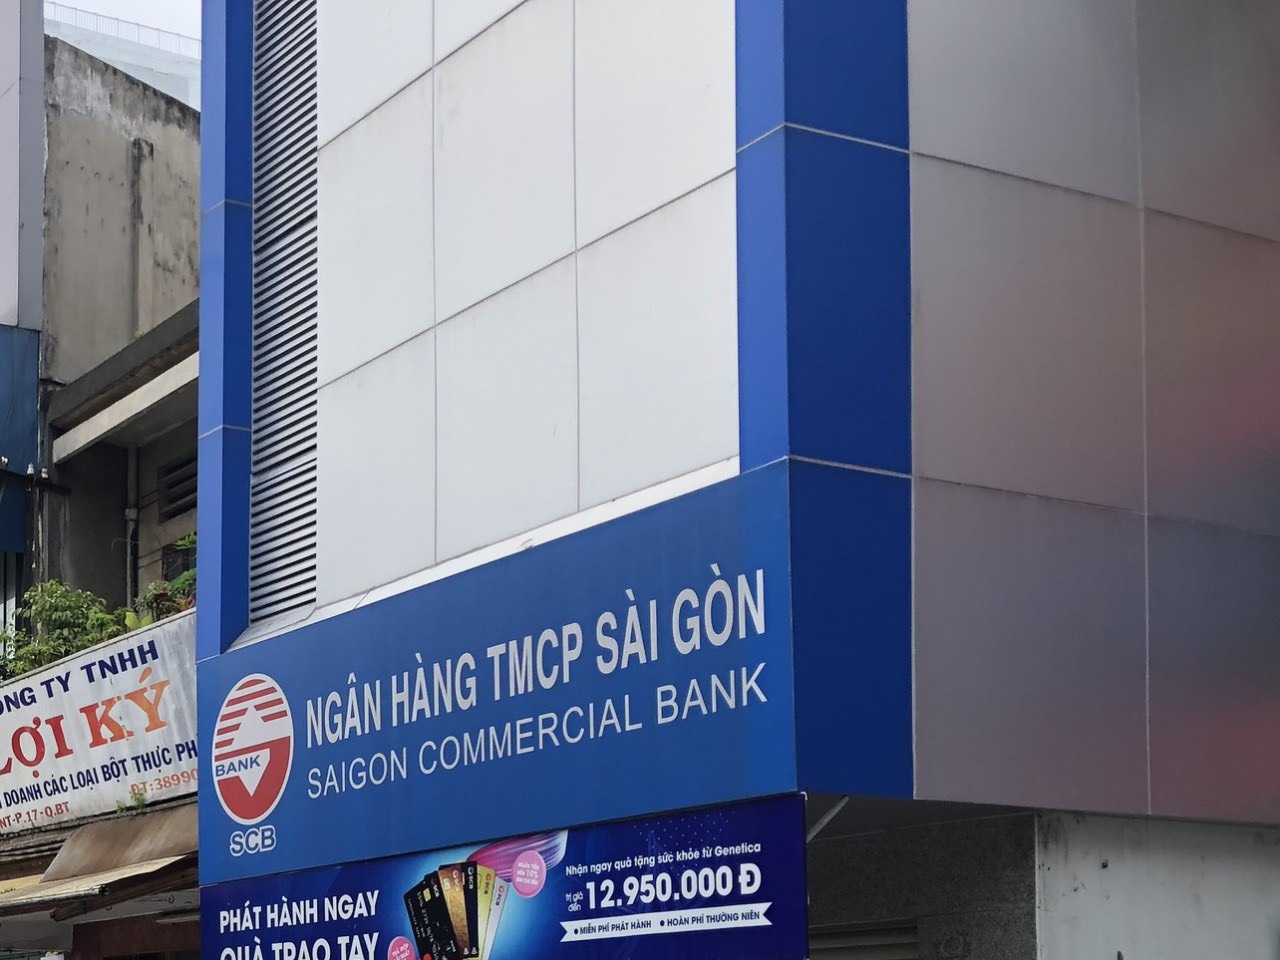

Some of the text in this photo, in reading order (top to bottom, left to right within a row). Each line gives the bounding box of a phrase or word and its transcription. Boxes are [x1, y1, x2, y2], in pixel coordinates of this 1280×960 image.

[40, 671, 71, 700] TY
[80, 640, 159, 684] TNHH
[306, 563, 765, 748] NGÂN HÀNG TMCP SÀI GÒN
[79, 667, 171, 749] KÝ
[308, 662, 768, 799] SAIGON COMMERCIAL BANK
[5, 784, 43, 807] DOANH
[43, 774, 69, 797] CÁC
[69, 768, 100, 791] LOẠI
[102, 756, 128, 783] BỘT
[131, 745, 173, 773] THỰC
[215, 755, 261, 777] BANK
[229, 825, 277, 857] SCB
[566, 842, 761, 877] Nhận ngay quà tặng sức khỏe từ Genetica
[586, 862, 762, 909] 12.950.000 Đ
[220, 897, 263, 933] PHÁT
[266, 893, 319, 929] HÀNH
[323, 890, 379, 923] NGAY
[580, 919, 652, 934] MIỄN PHÍ PHÁT HÀNH
[667, 914, 690, 927] HOÀN
[692, 913, 705, 925] PHÍ
